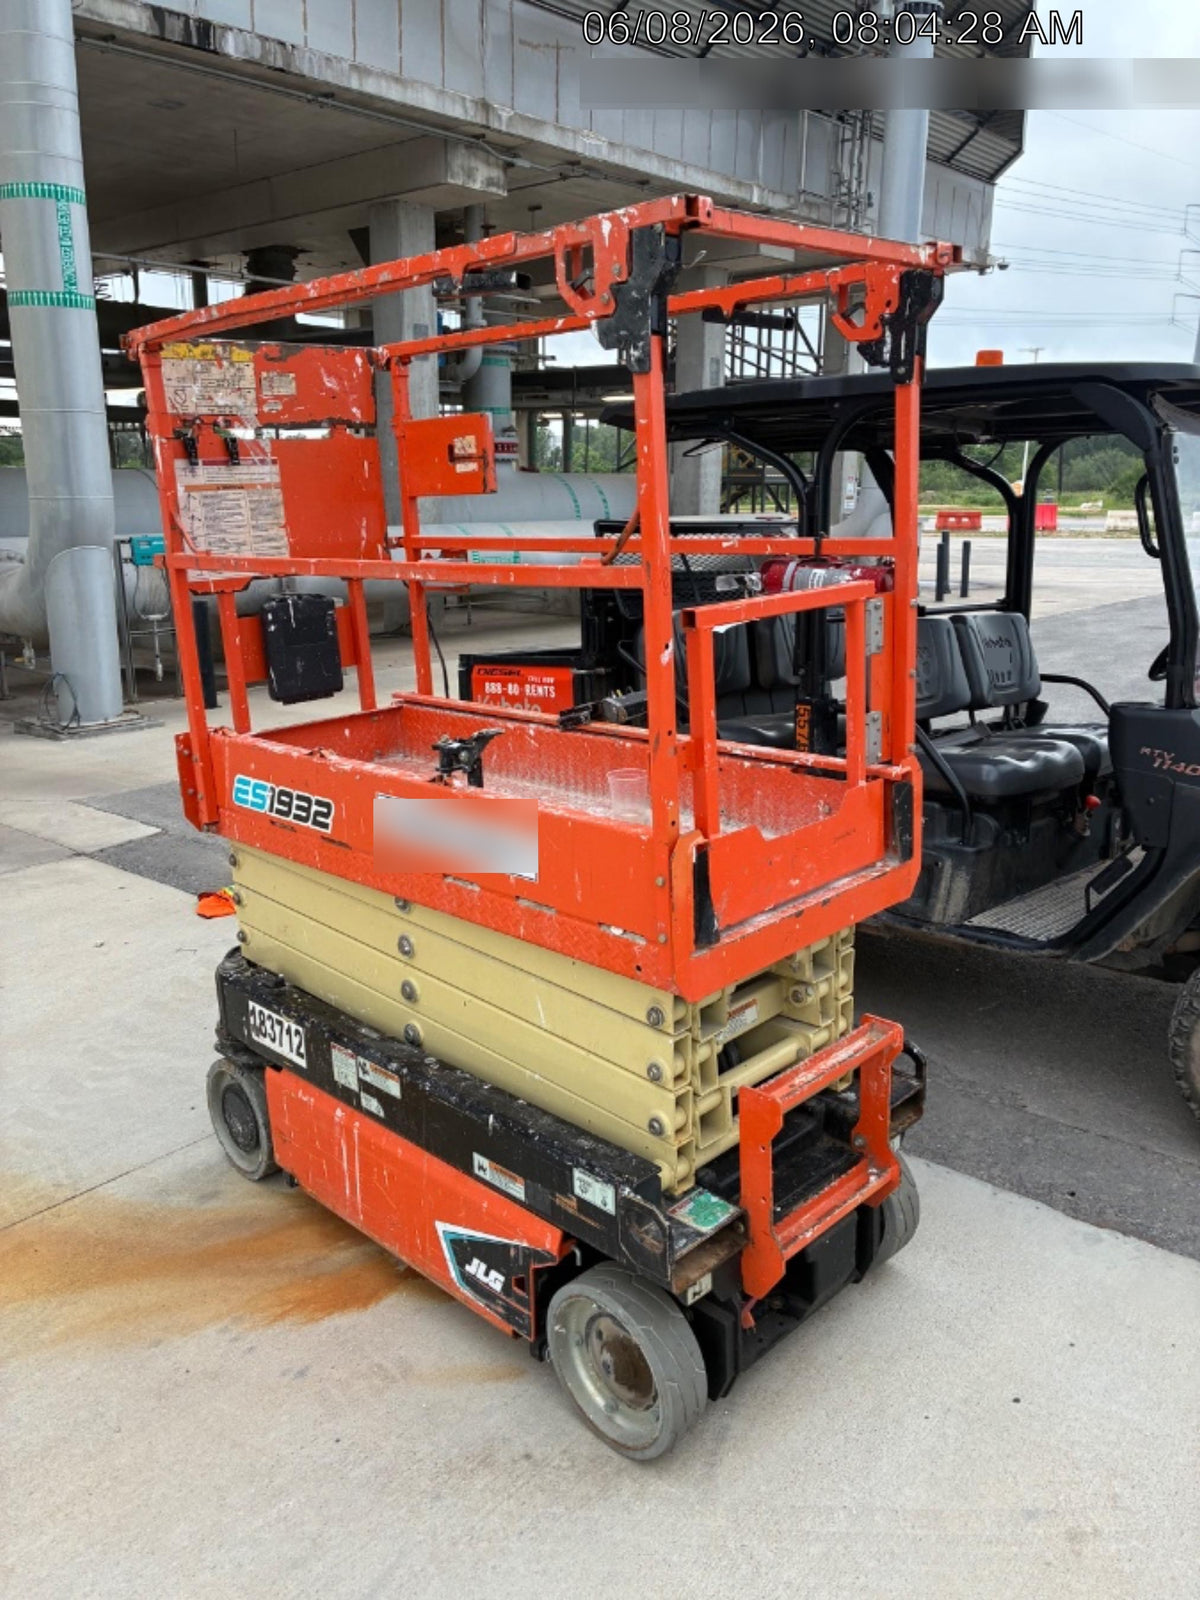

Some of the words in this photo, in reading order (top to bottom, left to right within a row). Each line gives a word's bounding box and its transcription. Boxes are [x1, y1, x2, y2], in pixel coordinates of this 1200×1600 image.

[1140, 746, 1175, 763] RTV
[1153, 758, 1200, 776] 1140
[233, 775, 334, 831] ES1932
[249, 1004, 305, 1061] 183712
[464, 1256, 506, 1292] JLG
